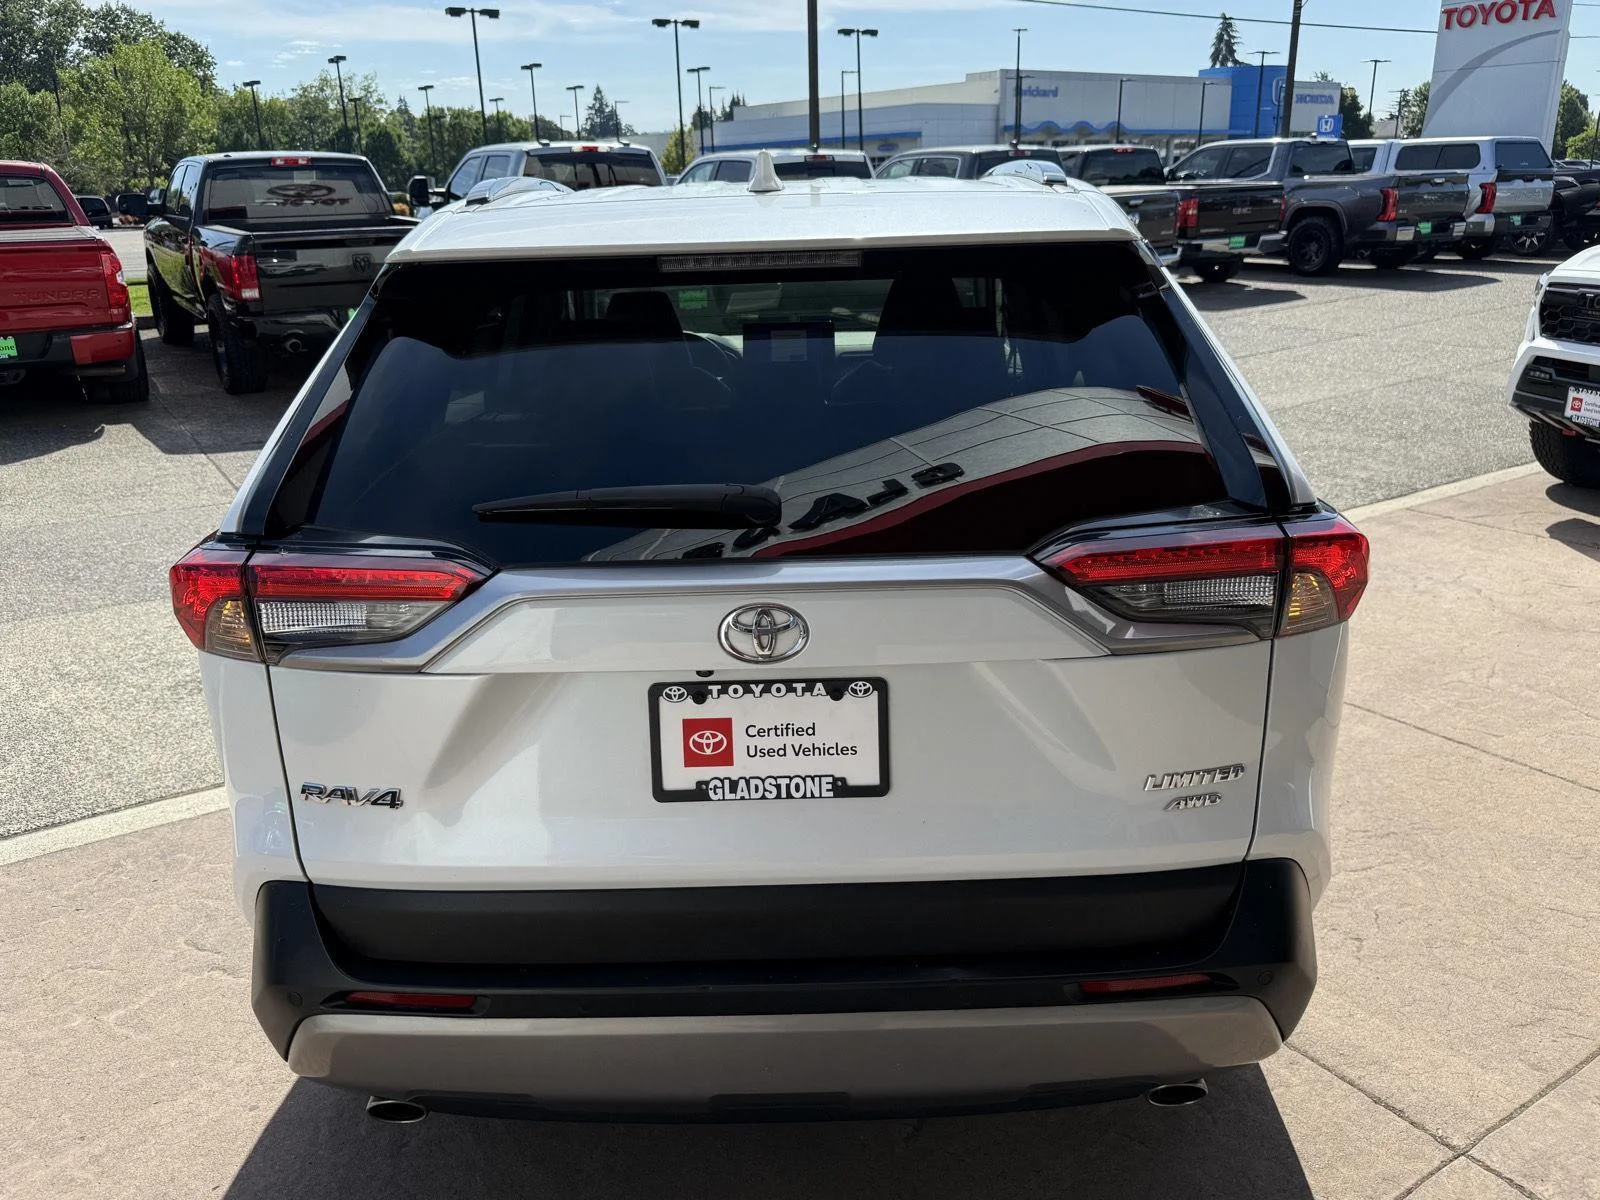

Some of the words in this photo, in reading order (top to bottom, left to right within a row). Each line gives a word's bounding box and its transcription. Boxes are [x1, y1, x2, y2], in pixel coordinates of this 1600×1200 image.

[1442, 0, 1556, 29] TOYOTA
[708, 682, 827, 699] TOYOTA
[745, 722, 816, 738] Certified
[746, 744, 787, 758] Used
[791, 742, 858, 757] Vehicles
[708, 775, 834, 801] GLADSTONE
[1143, 763, 1245, 791] LIMITED
[301, 782, 404, 809] RAV4
[1163, 792, 1222, 810] AWD
